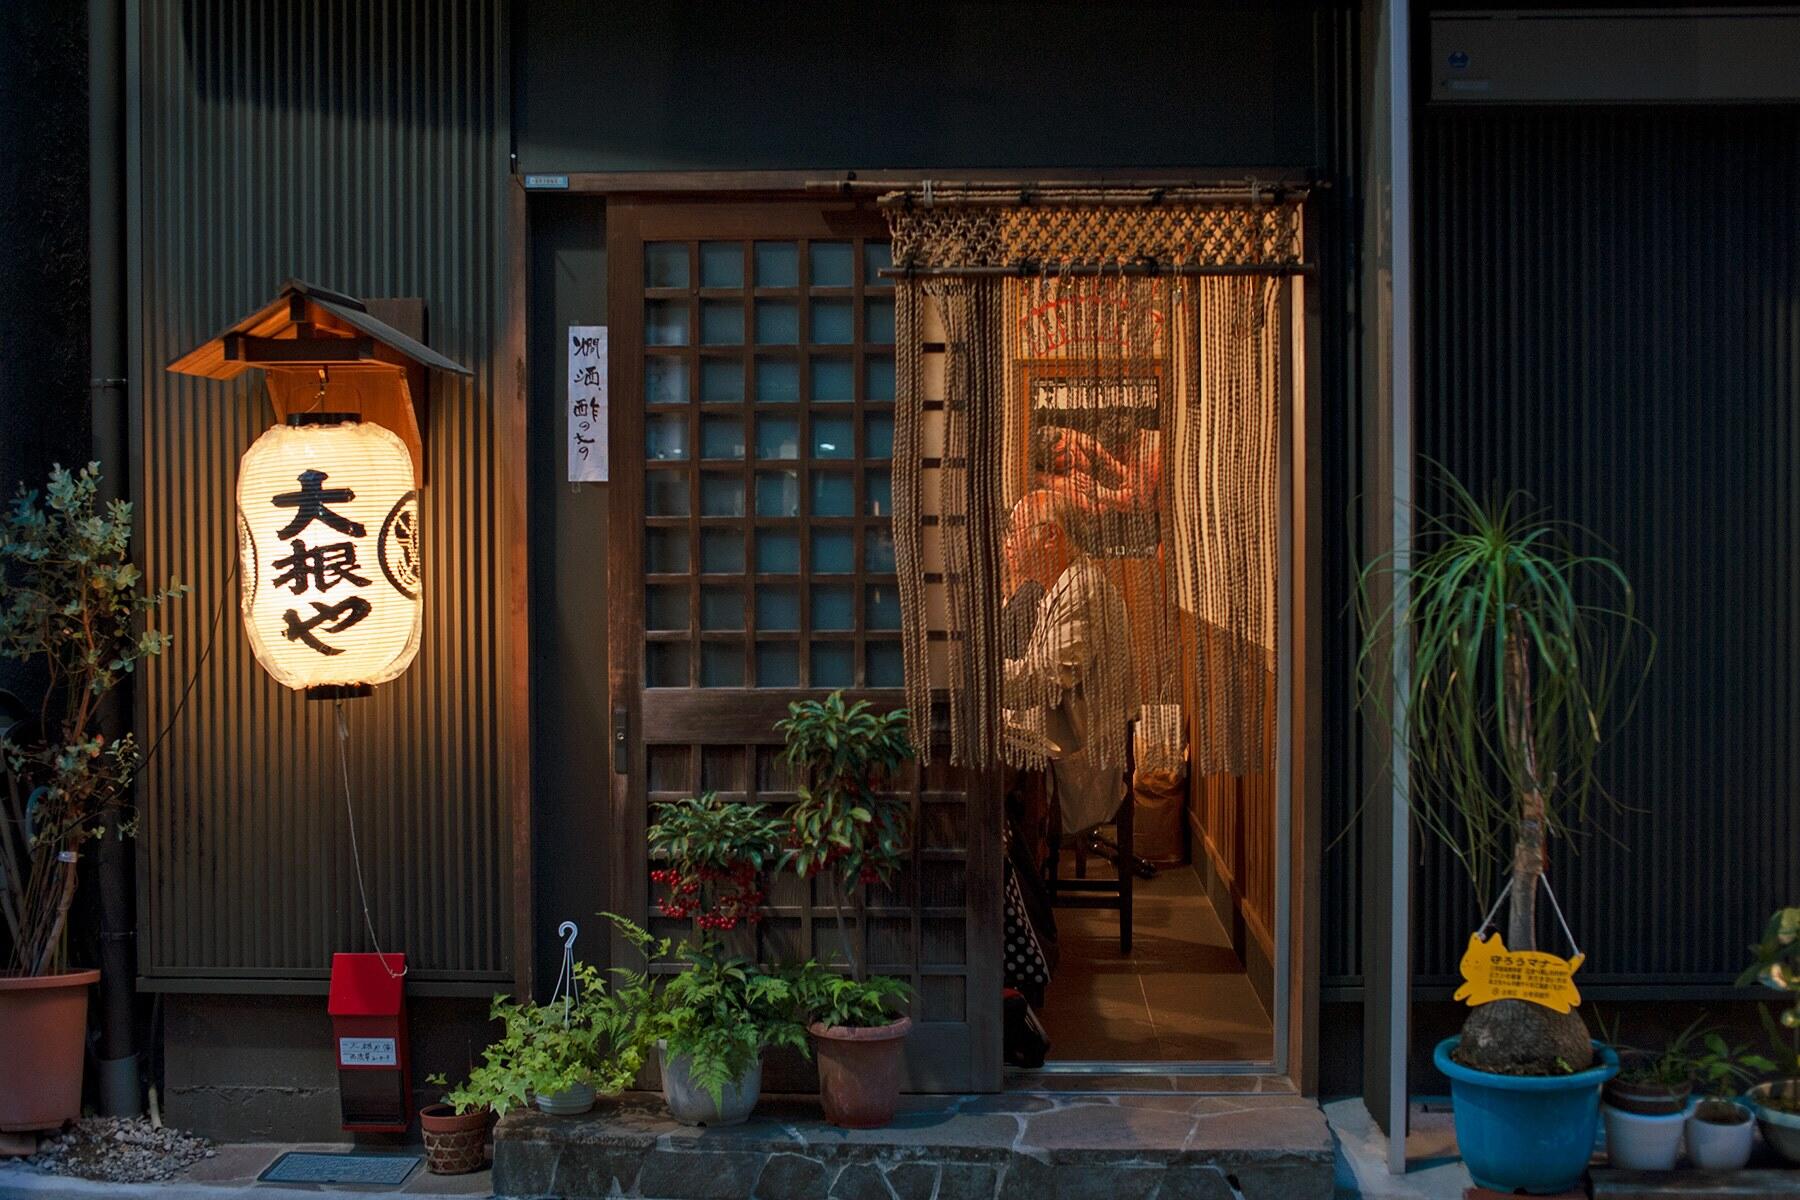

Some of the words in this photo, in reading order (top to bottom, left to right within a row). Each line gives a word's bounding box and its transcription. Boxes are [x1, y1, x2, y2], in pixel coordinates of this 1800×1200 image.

[271, 469, 373, 656] 大根や
[1490, 955, 1563, 968] 守ろうマナー
